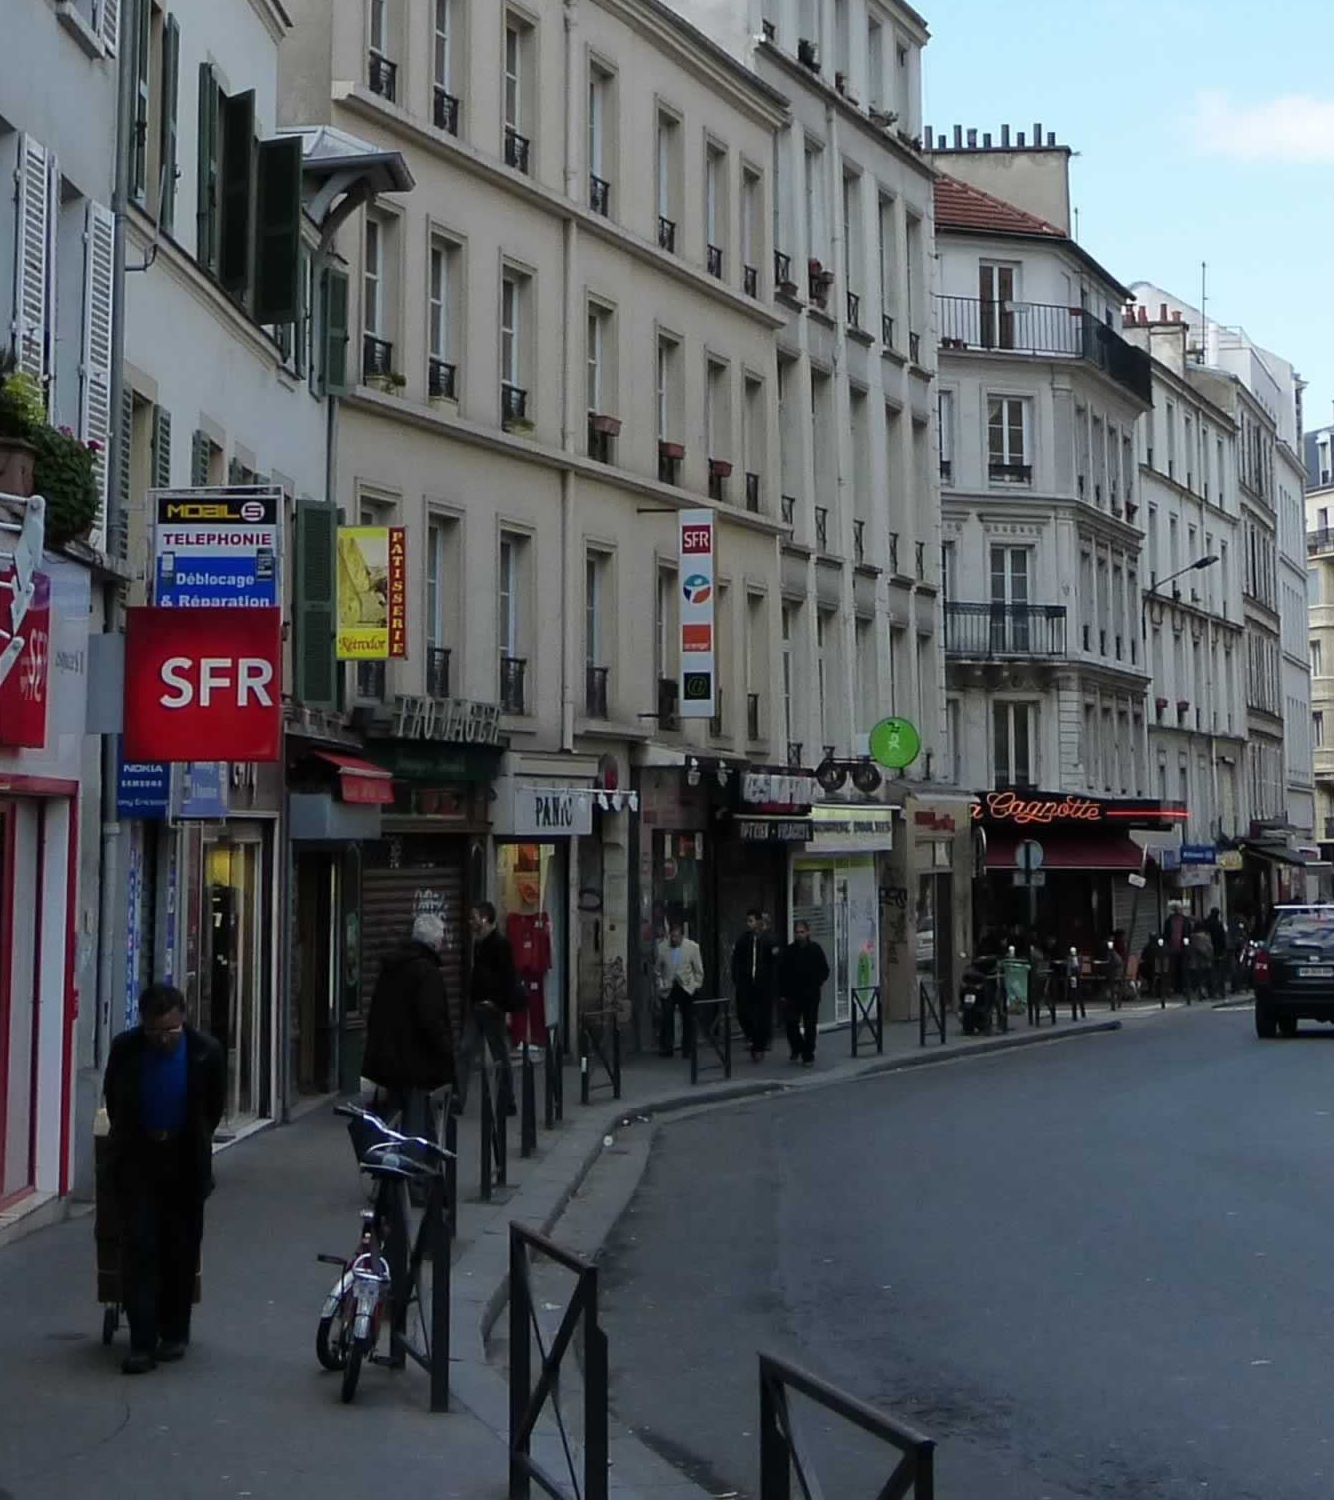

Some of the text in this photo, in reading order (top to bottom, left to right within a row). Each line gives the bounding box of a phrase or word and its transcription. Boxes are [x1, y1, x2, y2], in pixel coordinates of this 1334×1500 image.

[163, 533, 272, 546] TELEPHONIE
[683, 531, 710, 549] SFR
[175, 571, 255, 589] Déblocage
[160, 594, 270, 607] & Réparation
[391, 531, 405, 654] PATISSERIE
[159, 656, 274, 708] SFR
[122, 763, 164, 773] NOKIA
[986, 791, 1102, 824] Cagnotte
